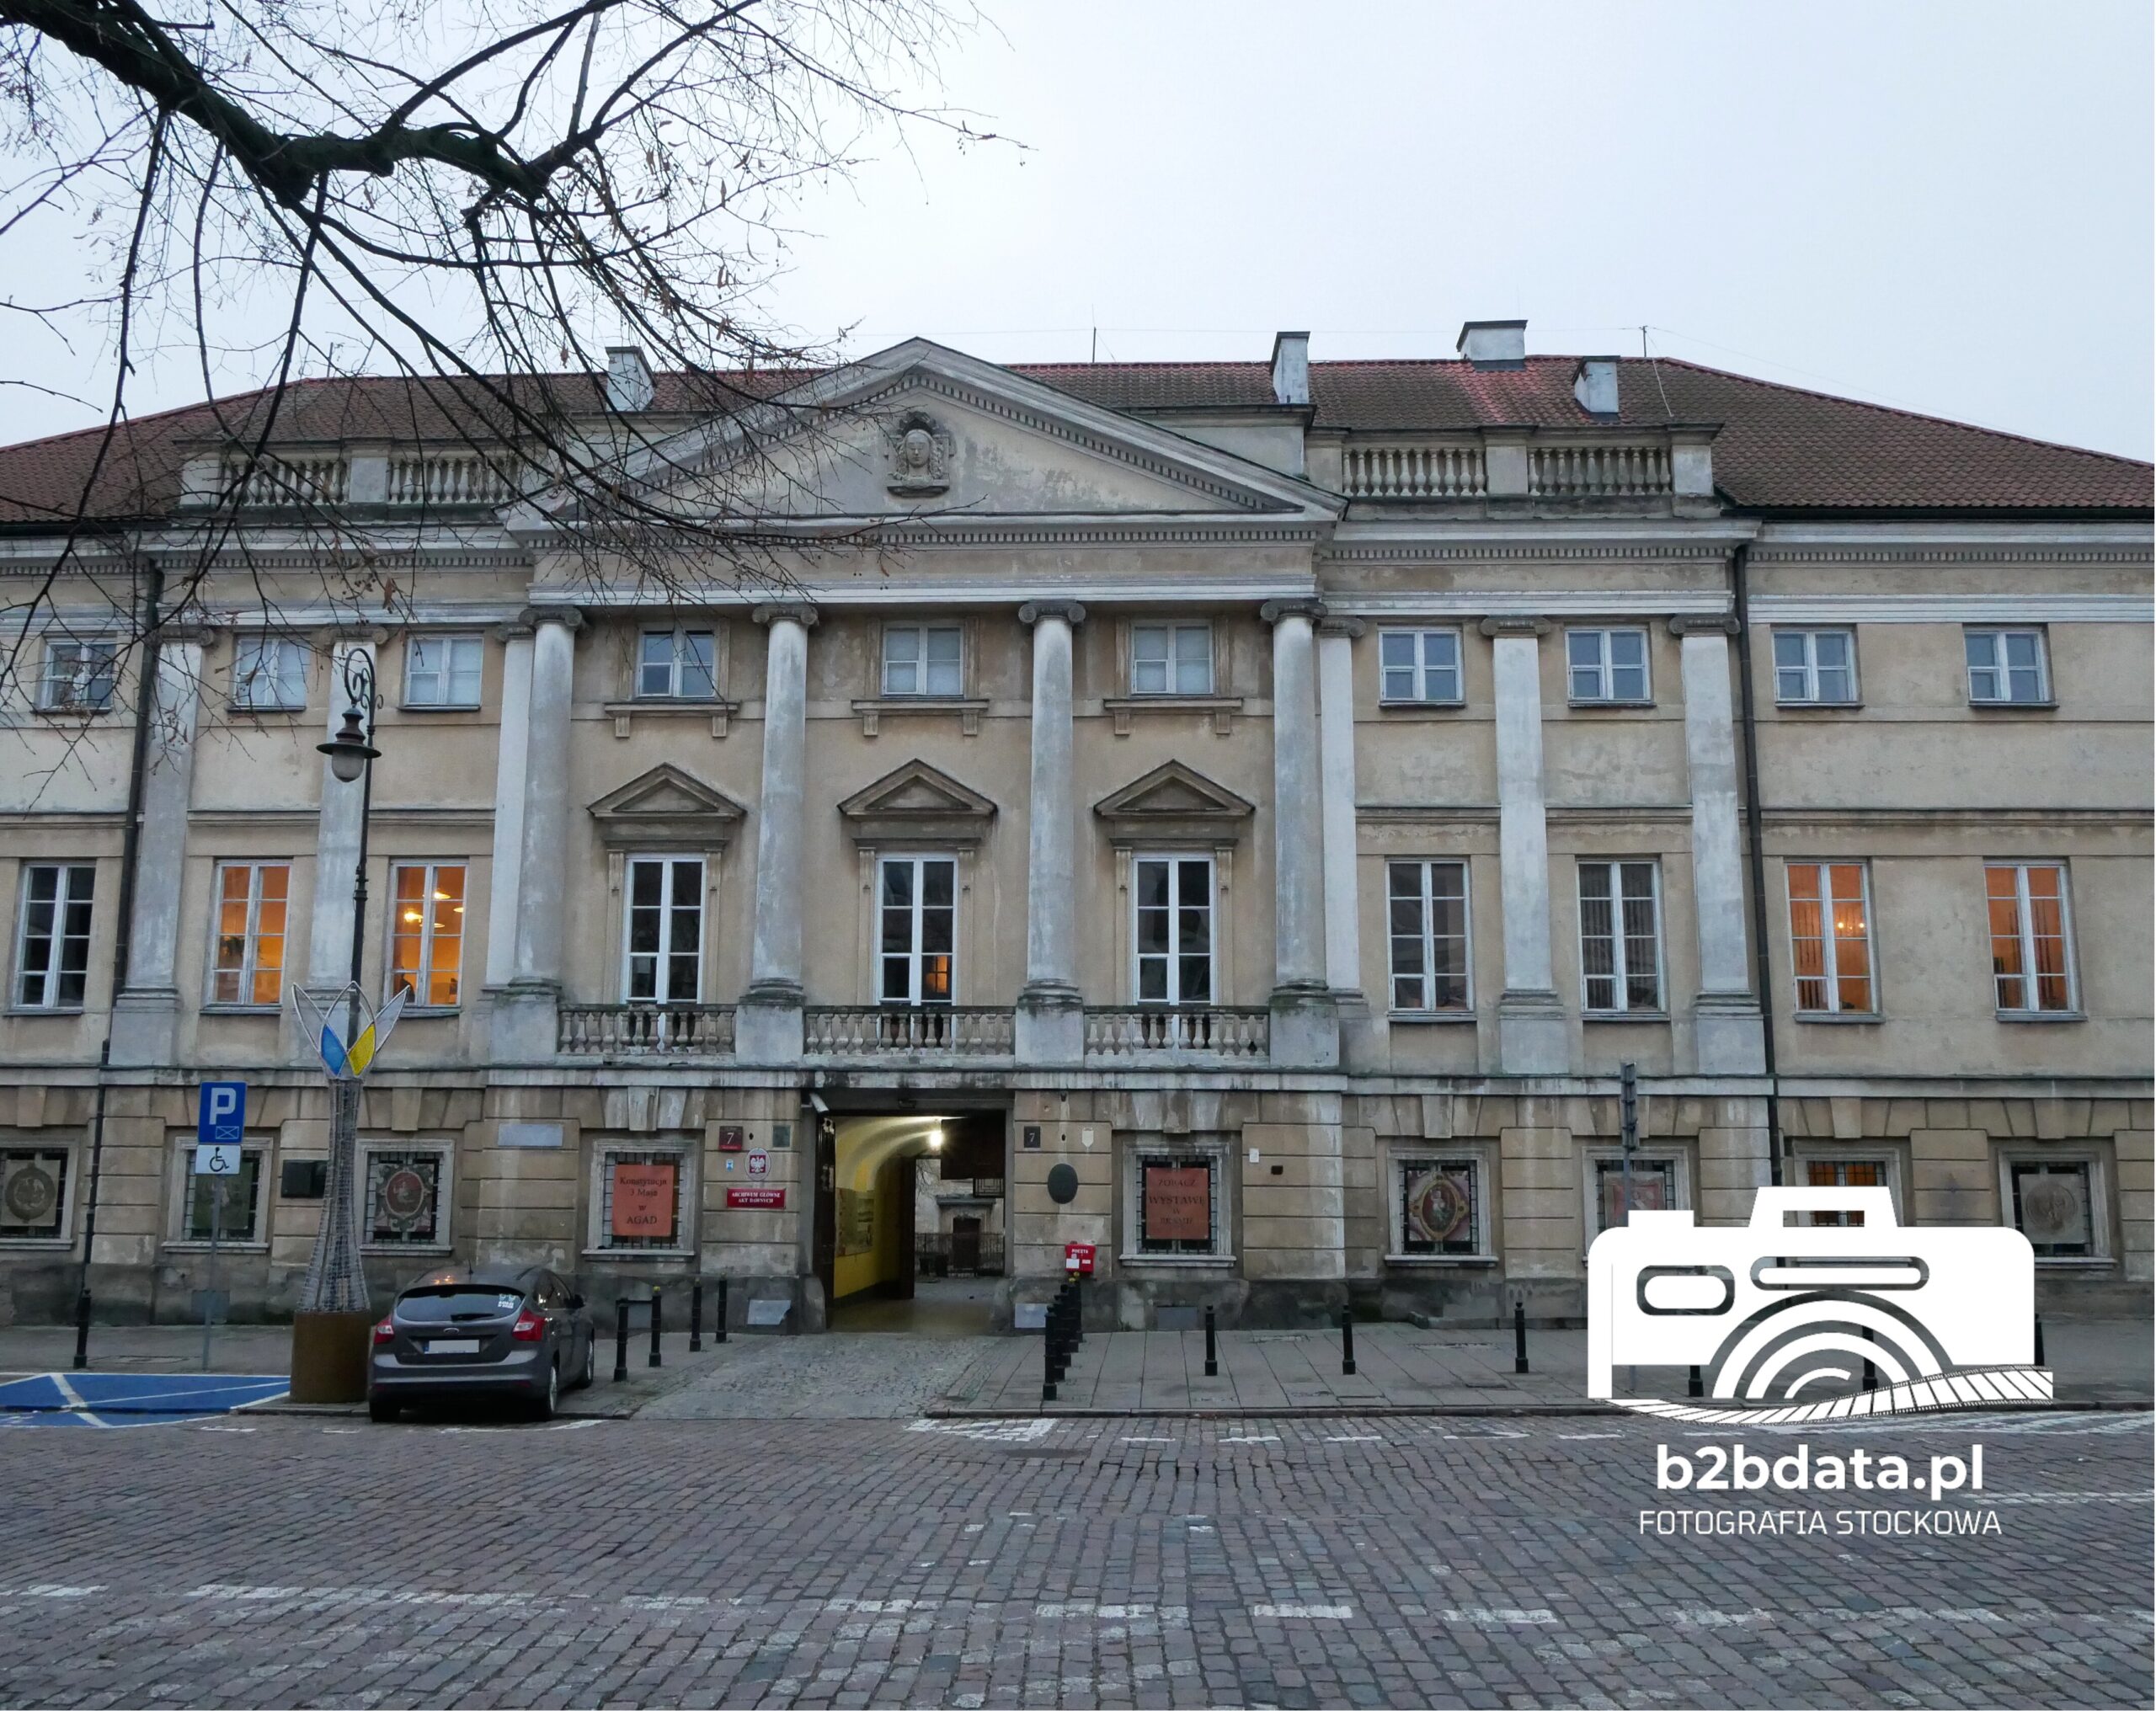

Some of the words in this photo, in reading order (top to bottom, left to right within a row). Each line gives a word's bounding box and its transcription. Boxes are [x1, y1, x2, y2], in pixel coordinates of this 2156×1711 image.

[209, 1087, 237, 1125] P
[727, 1132, 734, 1144] 7
[1029, 1133, 1035, 1143] 7
[626, 1215, 658, 1224] AGAD
